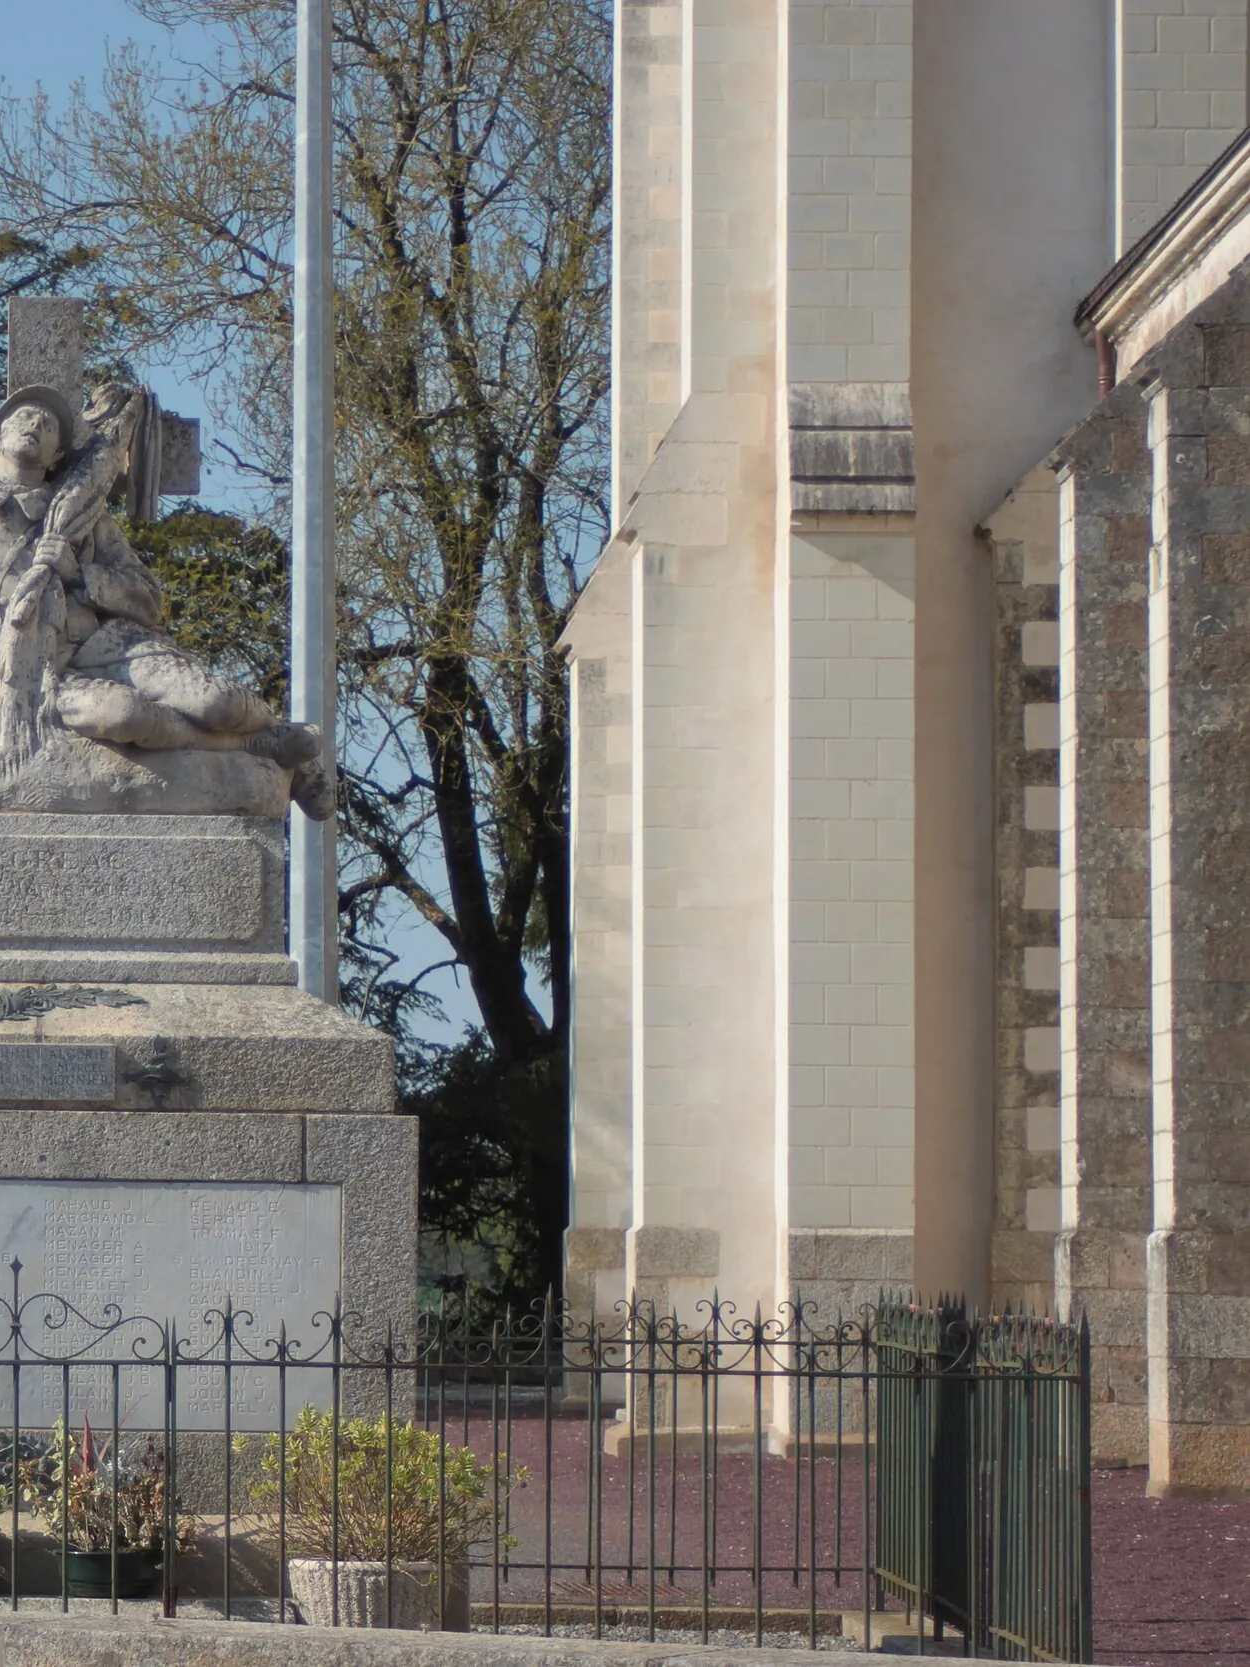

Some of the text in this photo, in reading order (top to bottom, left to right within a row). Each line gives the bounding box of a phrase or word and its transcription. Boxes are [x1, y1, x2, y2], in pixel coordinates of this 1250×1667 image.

[44, 1199, 113, 1211] MAHAUD
[190, 1200, 260, 1213] RENAUD
[44, 1213, 136, 1225] MARCHAND
[190, 1214, 247, 1226] SEROT
[44, 1226, 100, 1238] MAZAN
[189, 1227, 263, 1240] THOMAS
[43, 1239, 125, 1252] MENAGER
[239, 1241, 273, 1255] 1917
[43, 1253, 125, 1265] MENAGER
[43, 1266, 125, 1279] MENAGER
[189, 1268, 264, 1281] BLANDIN
[43, 1279, 130, 1292] MICHELET
[189, 1281, 282, 1294] CHAUSSEE
[43, 1373, 113, 1385] POULAIN
[188, 1375, 246, 1387] JOUN
[43, 1386, 113, 1399] POULAIN
[188, 1388, 246, 1401] JOUN
[43, 1400, 113, 1412] POULAIN
